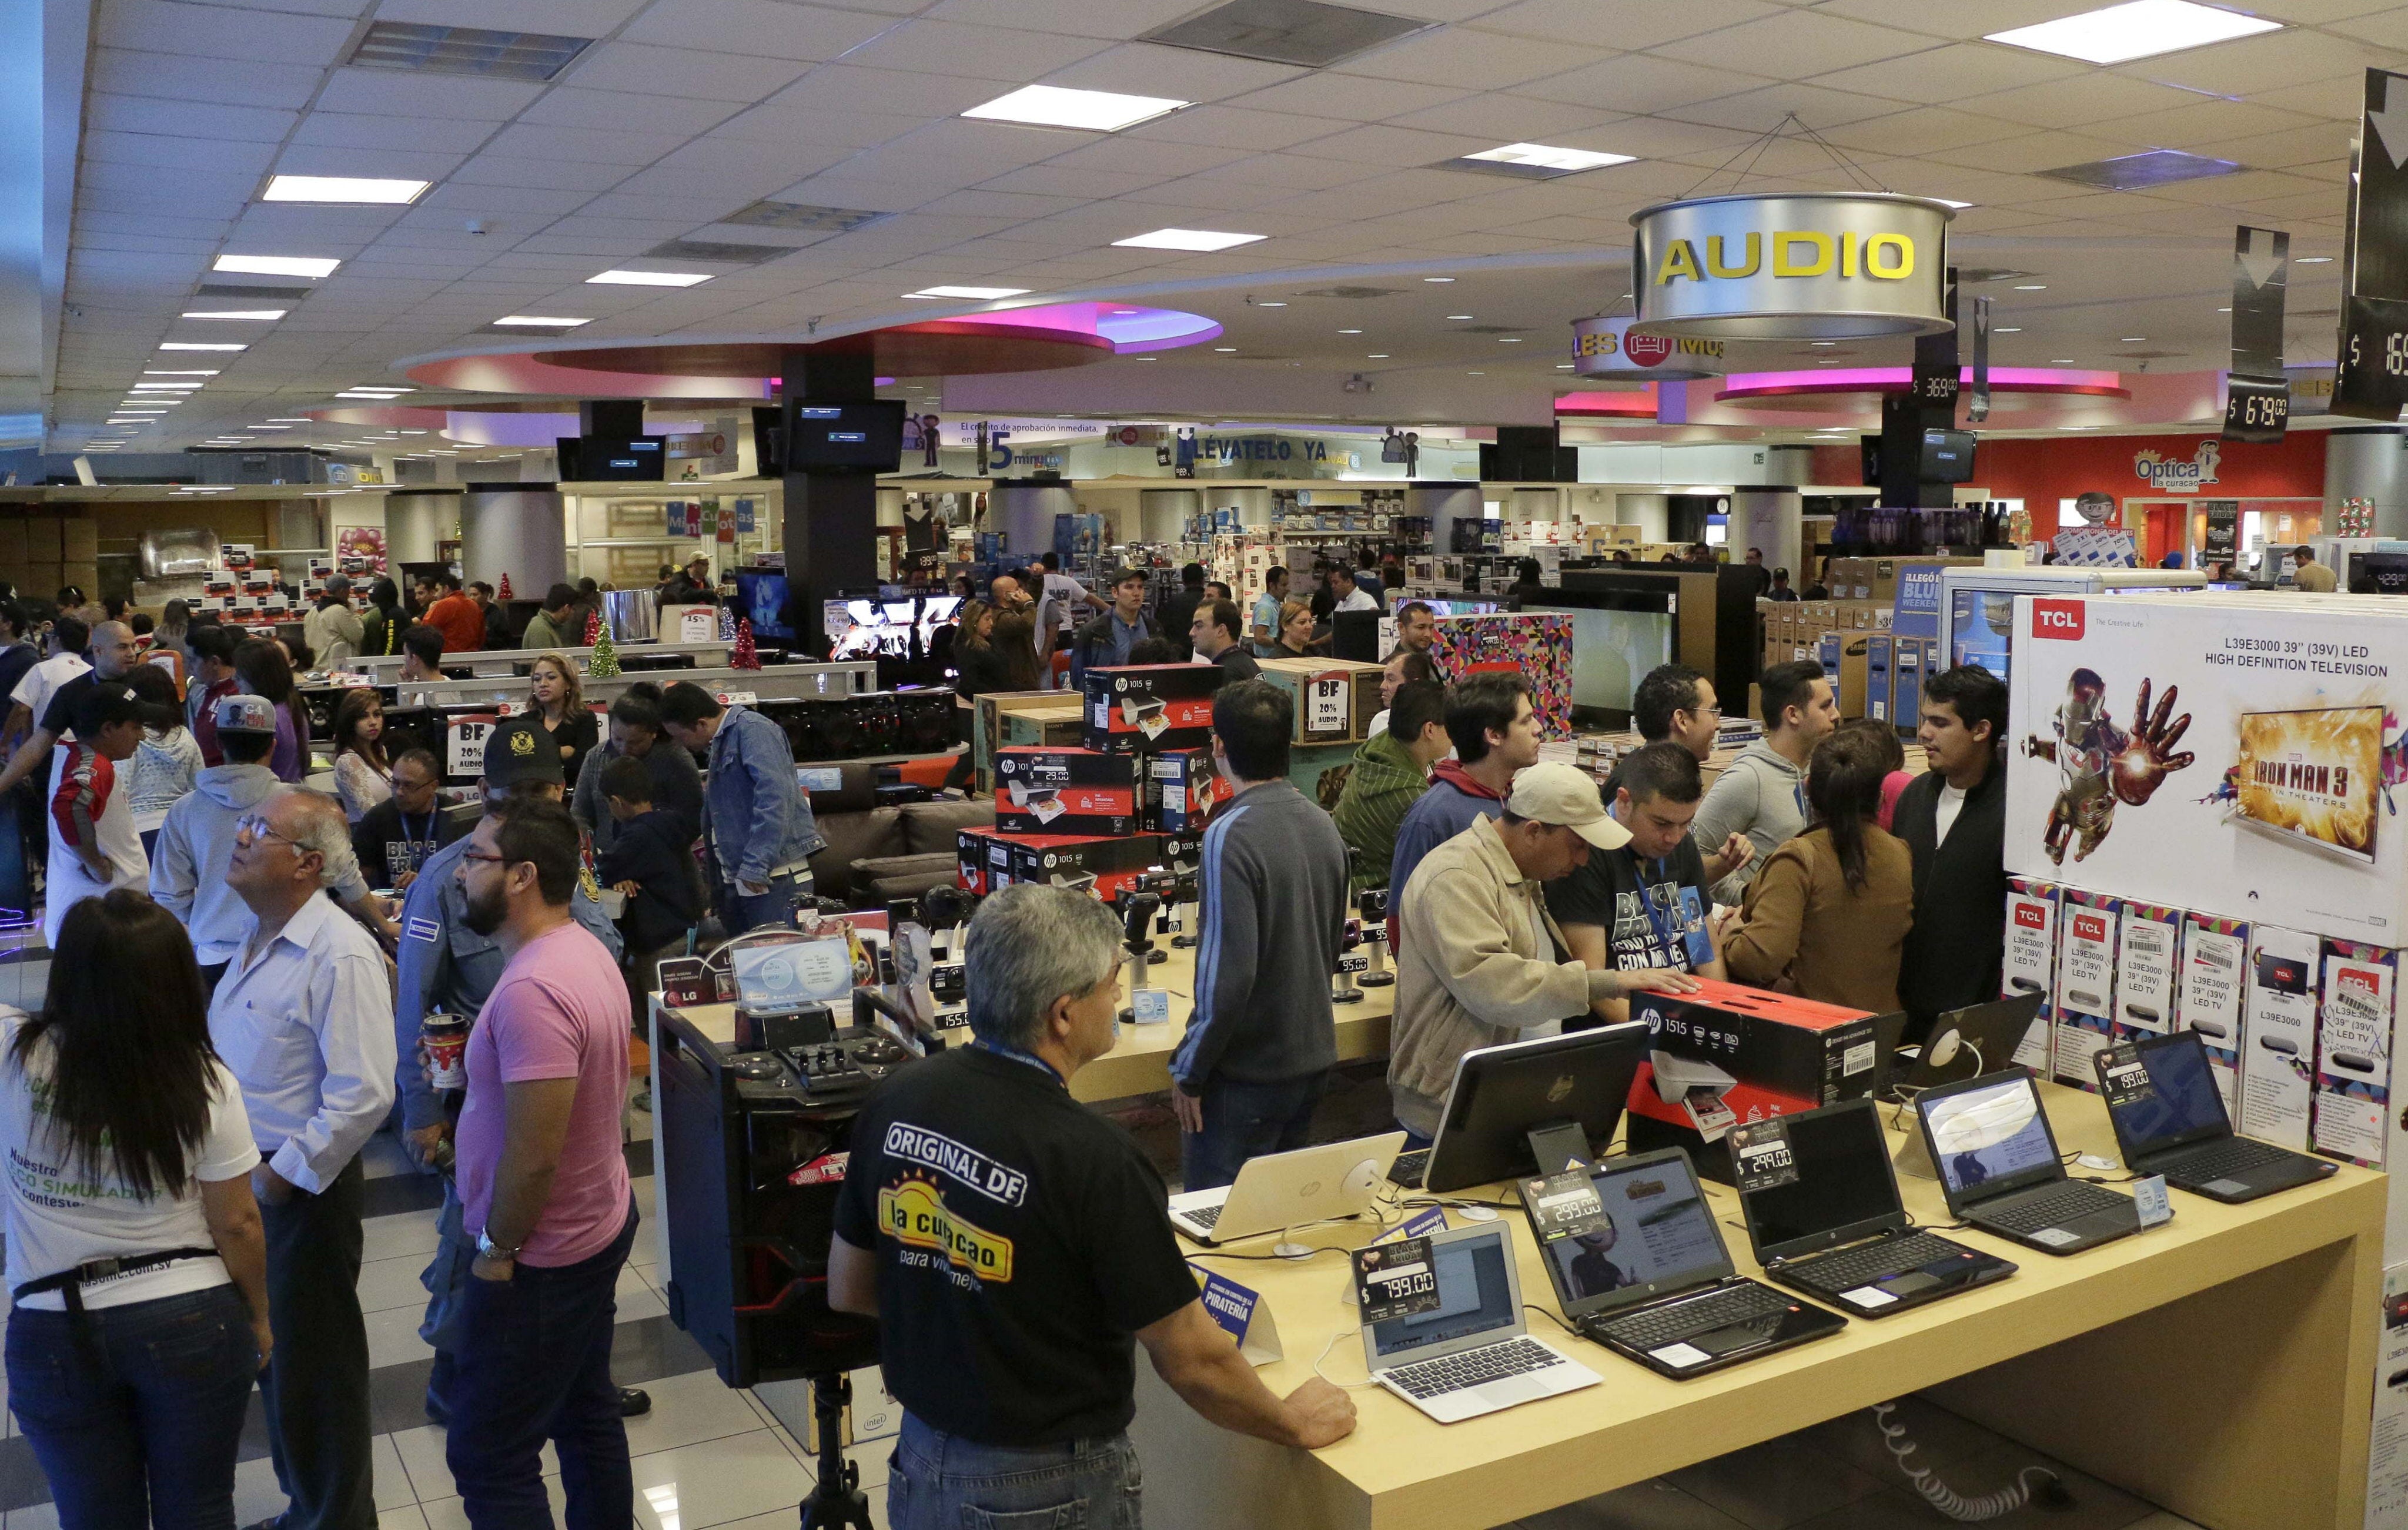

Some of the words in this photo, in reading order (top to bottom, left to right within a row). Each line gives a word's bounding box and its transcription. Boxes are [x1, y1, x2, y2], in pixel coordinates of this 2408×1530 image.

[1655, 231, 1915, 286] AUDIO
[2351, 334, 2360, 366] $
[2230, 398, 2236, 419] $
[2246, 396, 2286, 426] 679.00
[961, 423, 968, 431] El
[1001, 423, 1011, 431] de
[1012, 423, 1056, 434] aprobación
[1058, 424, 1098, 433] inmediata,
[990, 431, 1012, 469] 5
[1194, 434, 1291, 461] LÉVATELO
[1304, 440, 1327, 461] YA
[2137, 458, 2199, 486] Optica
[1905, 572, 1934, 582] ¡LLEGÓ
[1904, 582, 1939, 600] BLU
[1902, 598, 1937, 608] WEEKEN
[2039, 611, 2078, 629] TCL
[2095, 618, 2106, 627] The
[2107, 618, 2131, 627] Creative
[1851, 642, 1867, 652] SAMS
[2225, 638, 2280, 653] L39E3000
[2307, 642, 2339, 658] (39V)
[2343, 646, 2369, 658] LED
[2205, 652, 2235, 666] HIGH
[2238, 655, 2306, 671] DEFINITION
[2310, 659, 2388, 678] TELEVISION
[1115, 677, 1127, 692] hp
[1129, 679, 1143, 688] 1015
[1318, 681, 1339, 697] BF
[243, 704, 263, 714] G4
[1319, 704, 1337, 713] 20%
[459, 724, 485, 741] BF
[461, 747, 483, 757] 20%
[1001, 759, 1015, 774] hp
[1045, 772, 1069, 781] 29.00
[2254, 760, 2287, 786] IRON
[2290, 764, 2329, 795] MAN
[2333, 766, 2348, 797] 3
[466, 792, 479, 801] LG
[2289, 791, 2347, 809] THEATERS
[1168, 841, 1179, 855] hp
[1044, 853, 1056, 868] hp
[1059, 855, 1072, 863] 1015
[2019, 910, 2041, 922] TCL
[1168, 922, 1179, 933] hp
[2078, 921, 2100, 935] TCL
[2013, 936, 2044, 949] L39E3000
[2025, 948, 2042, 959] (39V)
[2071, 948, 2103, 962] L39E3000
[1343, 959, 1366, 971] 95.00
[2014, 956, 2026, 965] LED
[2027, 959, 2038, 967] TV
[2083, 960, 2101, 972] (39V)
[2128, 961, 2162, 976] L39E3000
[2072, 969, 2085, 979] LED
[2086, 972, 2097, 981] TV
[2141, 975, 2159, 987] (39V)
[2276, 970, 2290, 978] TCL
[2129, 982, 2143, 992] LED
[2145, 986, 2155, 995] TV
[2193, 975, 2230, 990] L39E3000
[682, 991, 697, 1001] LG
[2206, 988, 2227, 1002] (39V)
[2193, 997, 2209, 1007] LED
[2210, 1001, 2222, 1010] TV
[1641, 1008, 1661, 1034] hp
[1665, 1019, 1687, 1035] 1515
[2260, 1011, 2300, 1027] L39E3000
[2352, 1020, 2374, 1032] (39V)
[2337, 1030, 2355, 1040] LED
[2358, 1034, 2369, 1043] TV
[2105, 1080, 2112, 1093] $
[2121, 1070, 2149, 1088] 199.00
[887, 1127, 981, 1185] ORIGINAL
[986, 1171, 1022, 1200] DE
[1737, 1161, 1744, 1176] $
[1752, 1149, 1792, 1173] 299.00
[1536, 1211, 1545, 1225] $
[1553, 1197, 1602, 1221] 299.00
[891, 1198, 907, 1230] la
[917, 1211, 996, 1268] curacao
[1389, 1240, 1422, 1254] BLACK
[900, 1249, 928, 1268] para
[1390, 1250, 1423, 1264] FRIDAY
[1361, 1287, 1370, 1304] $
[1382, 1272, 1434, 1298] 799.00
[1205, 1290, 1249, 1322] PIRATERÍA
[865, 1415, 884, 1429] intel
